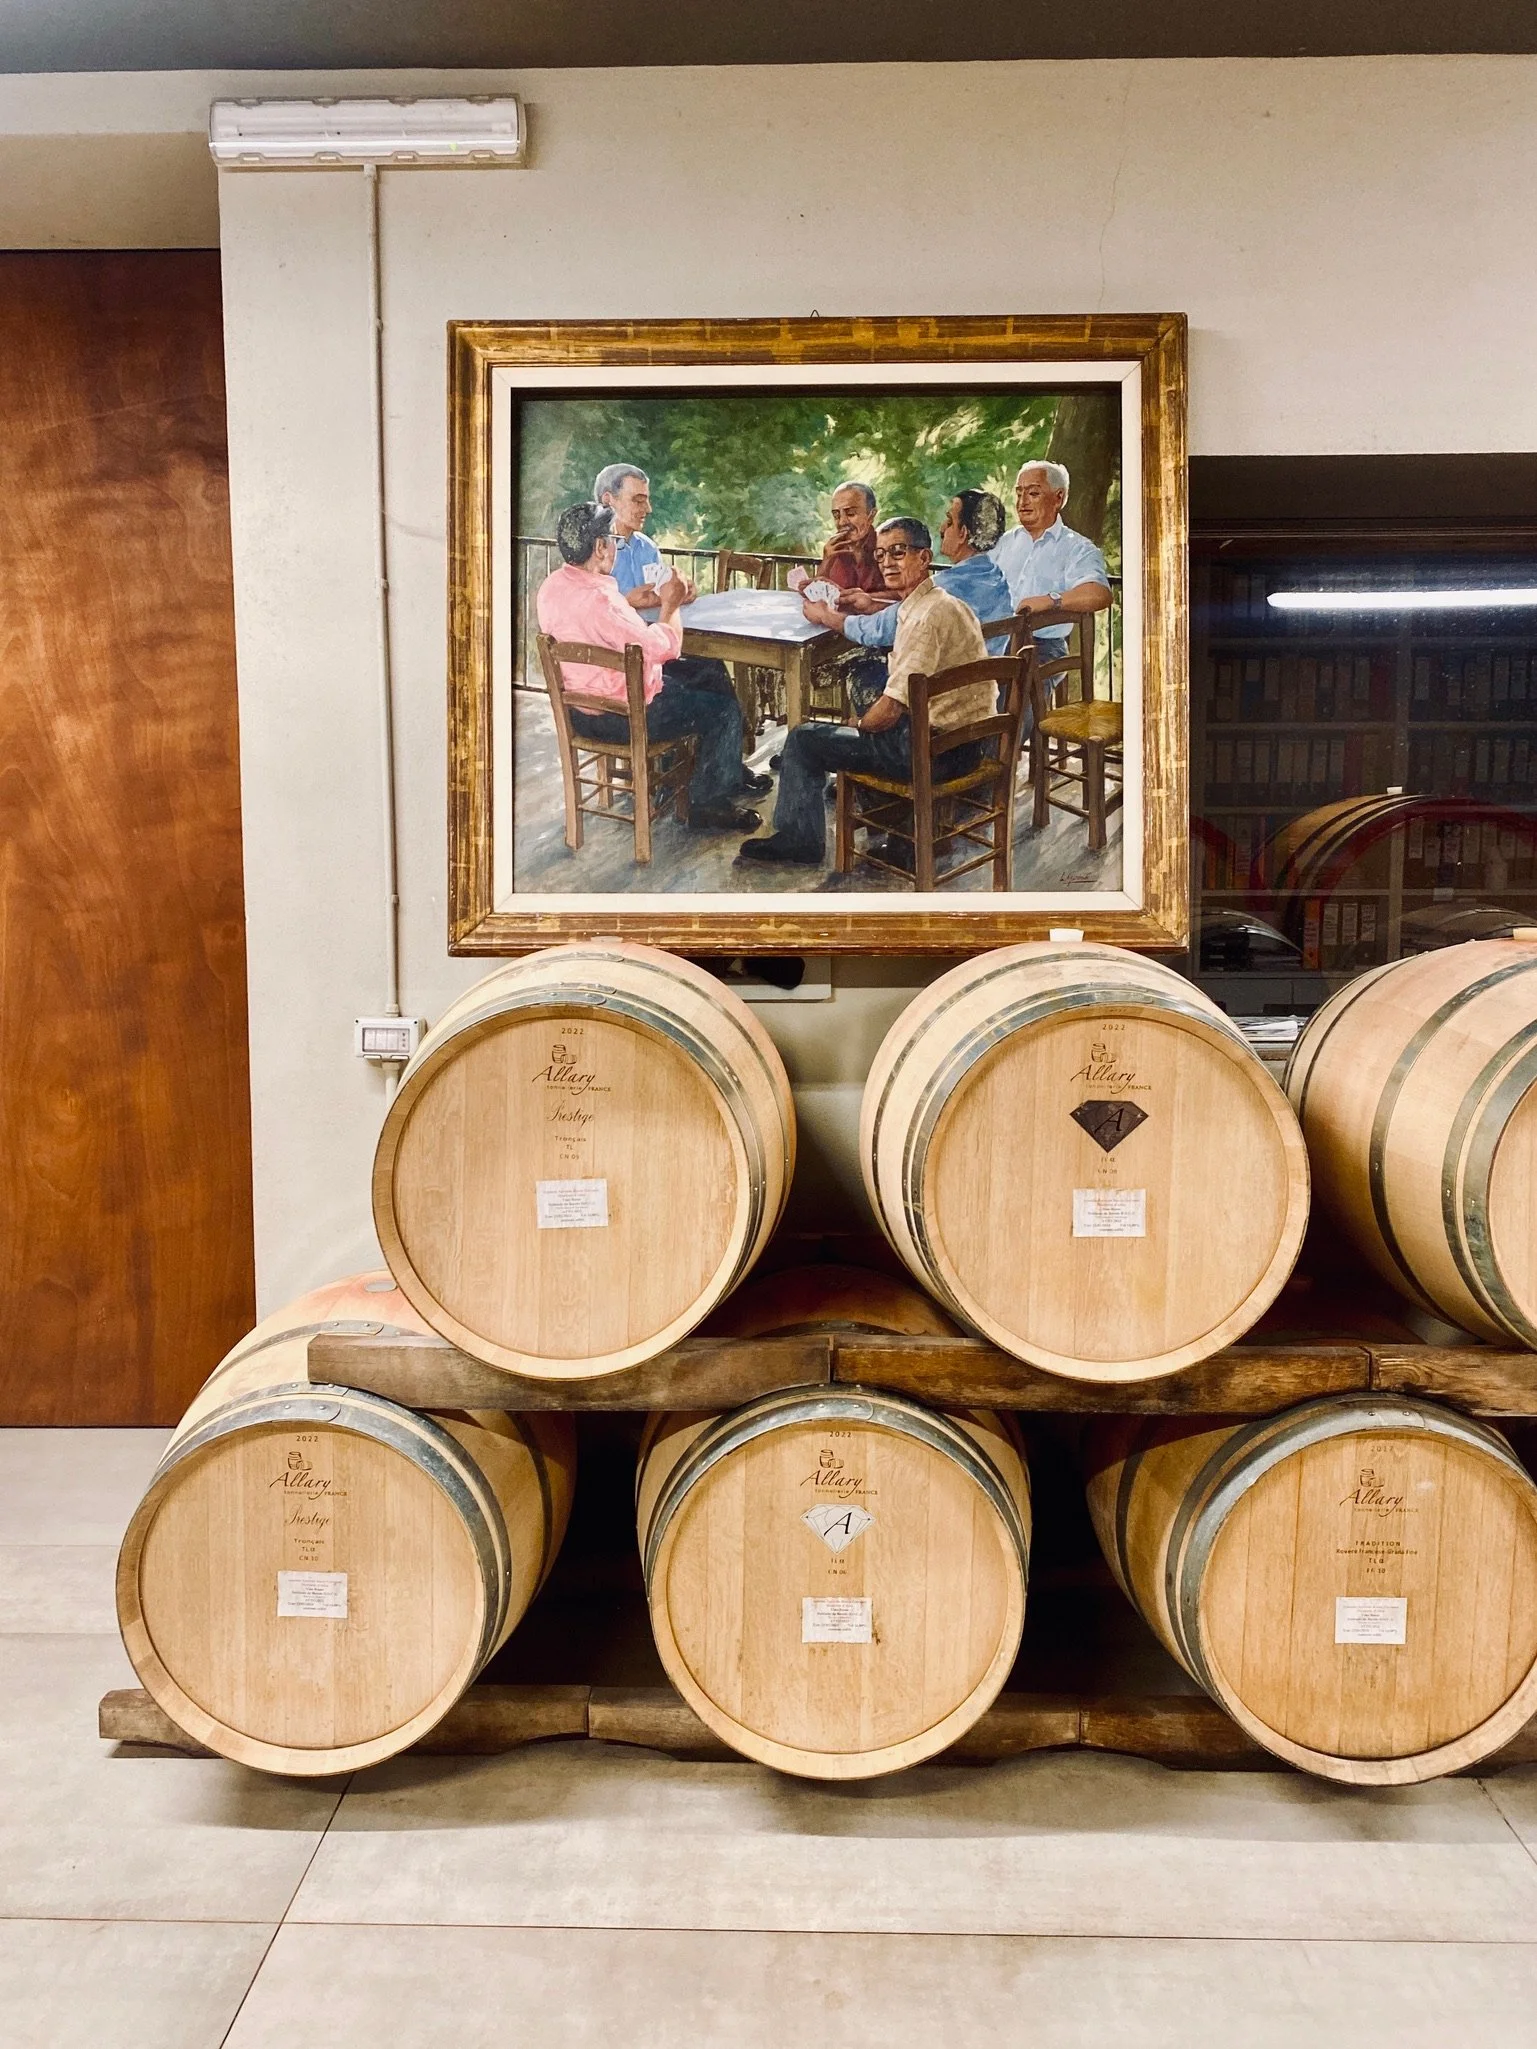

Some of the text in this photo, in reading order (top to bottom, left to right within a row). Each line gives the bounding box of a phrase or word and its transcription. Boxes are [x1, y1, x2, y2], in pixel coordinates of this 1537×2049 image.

[561, 1027, 584, 1035] 2022
[532, 1065, 596, 1096] Allary
[1070, 1064, 1136, 1094] Allary
[1094, 1108, 1125, 1133] A
[269, 1471, 331, 1500] Allary
[800, 1470, 863, 1499] Allary
[1339, 1488, 1404, 1517] Allary
[823, 1511, 852, 1536] A
